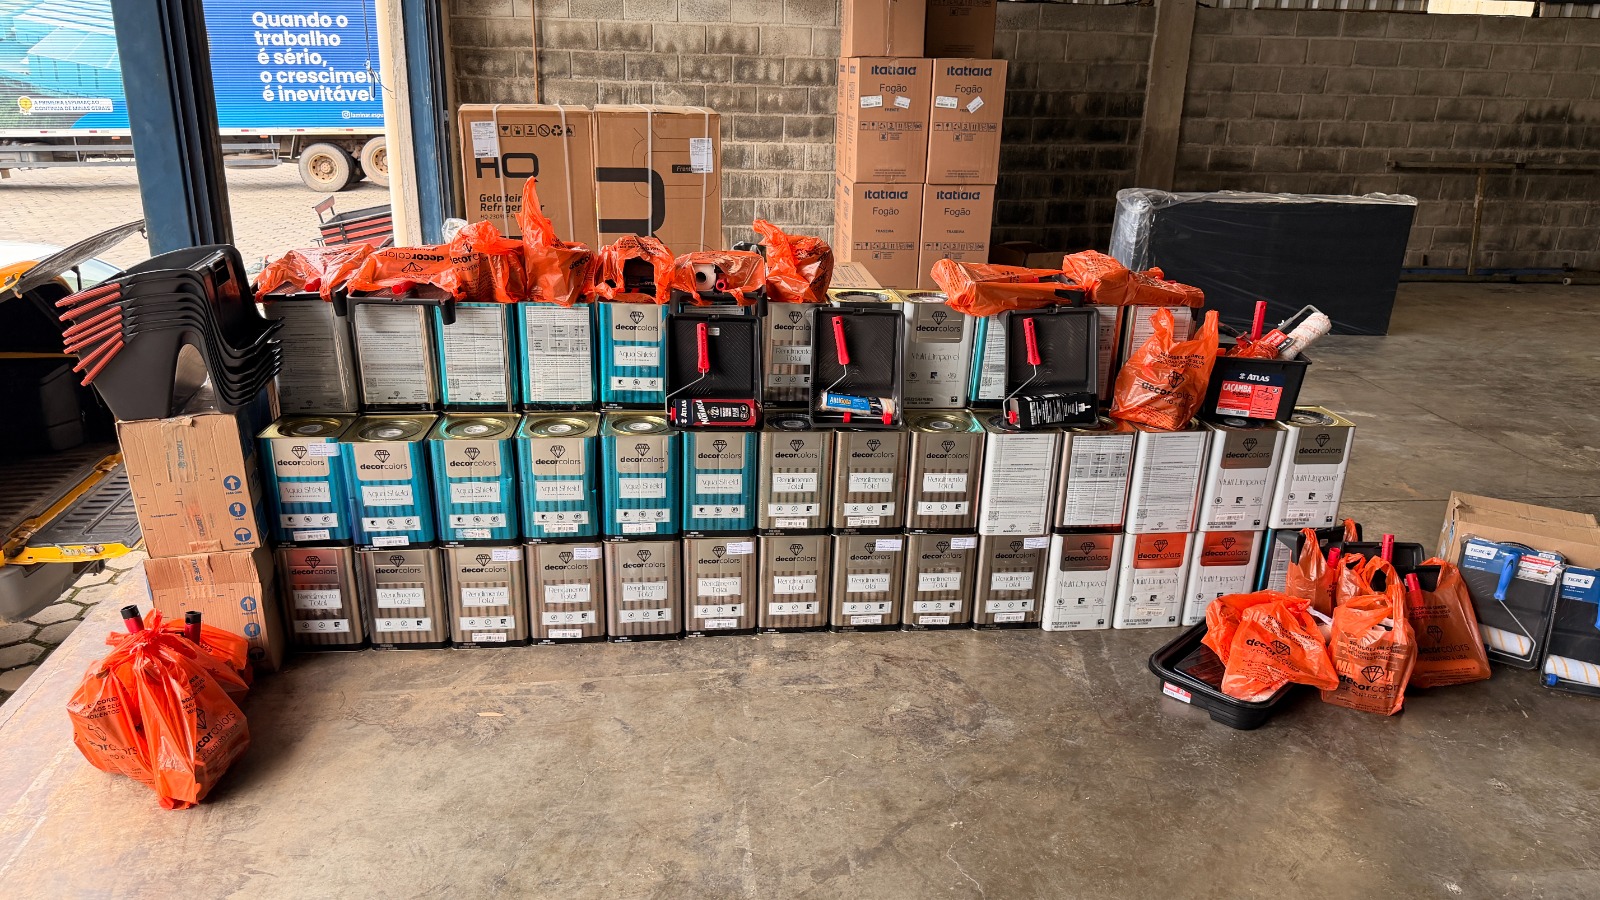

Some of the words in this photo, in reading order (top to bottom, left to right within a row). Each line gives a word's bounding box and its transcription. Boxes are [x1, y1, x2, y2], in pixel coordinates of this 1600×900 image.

[252, 12, 332, 29] Quando
[336, 15, 348, 27] o
[254, 30, 340, 46] trabalho
[258, 48, 269, 64] é
[274, 48, 326, 67] sério,
[260, 71, 272, 83] o
[276, 67, 380, 83] crescimen
[871, 65, 916, 75] itatiaia
[947, 66, 992, 76] itatiaia
[263, 85, 274, 101] é
[278, 85, 374, 101] inevitável
[880, 84, 907, 93] Fogão
[955, 85, 982, 94] Fogão
[480, 194, 522, 202] Geladeir
[865, 190, 908, 199] itatiaia
[937, 191, 980, 200] itatiaia
[873, 207, 899, 216] Fogão
[944, 208, 970, 217] Fogão
[1247, 374, 1270, 382] ATLAS
[1223, 383, 1252, 393] CAÇAMBA
[195, 710, 236, 753] ecorcolors
